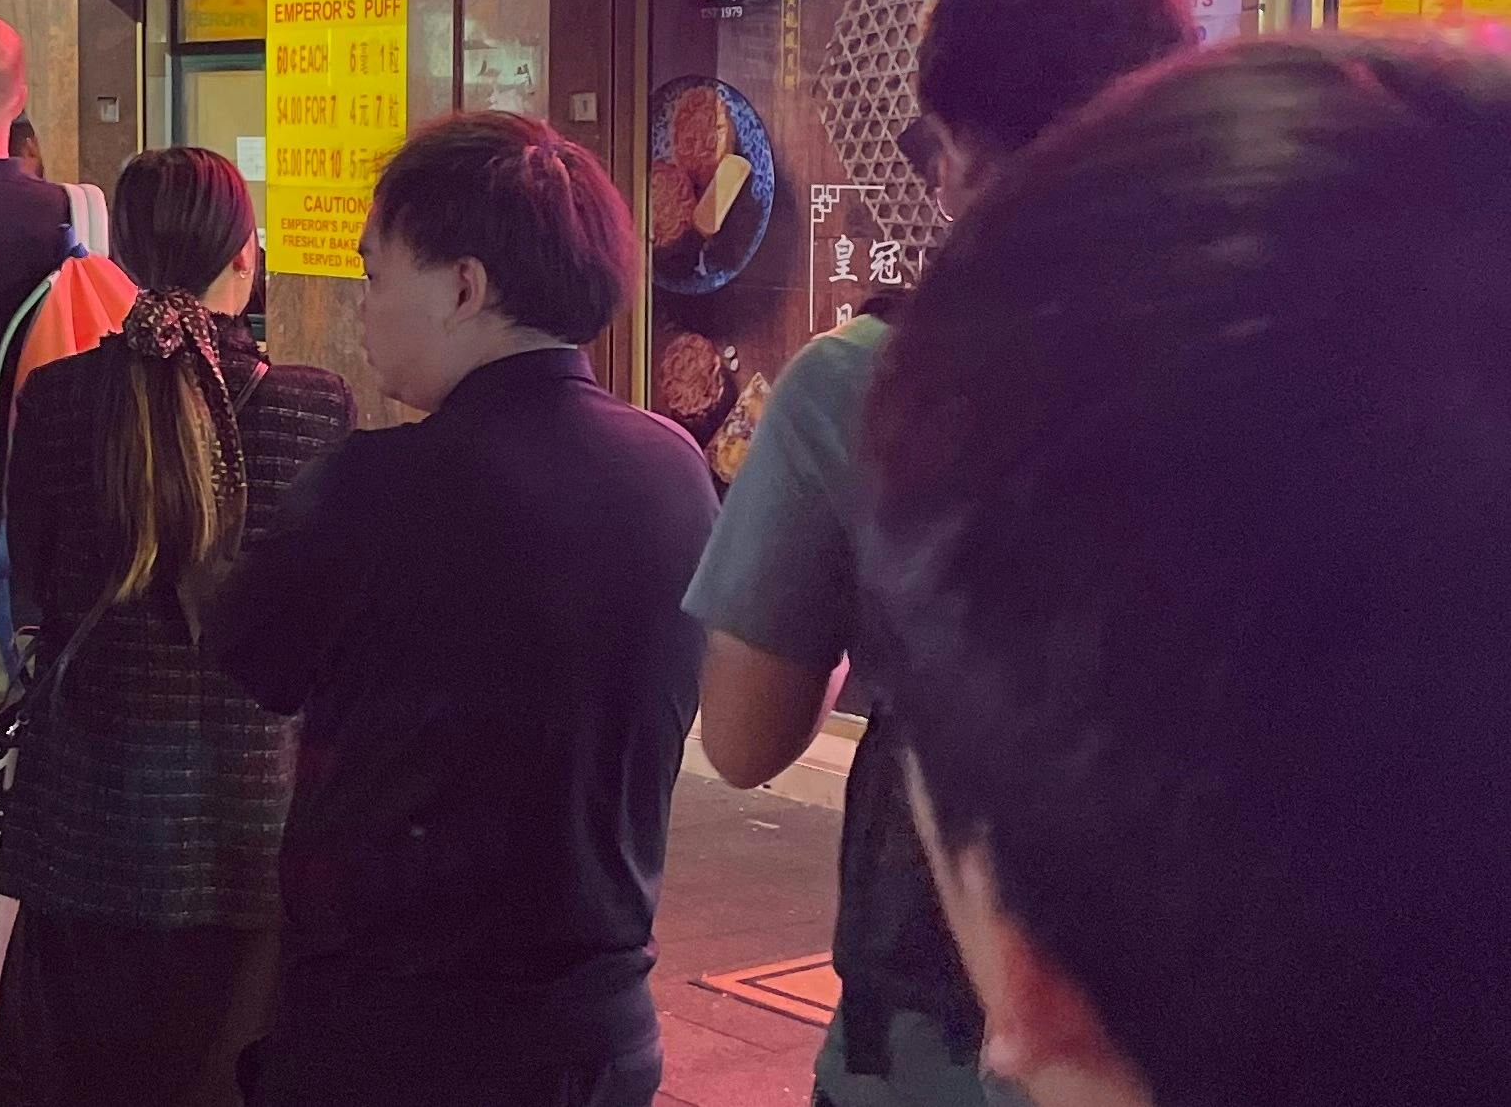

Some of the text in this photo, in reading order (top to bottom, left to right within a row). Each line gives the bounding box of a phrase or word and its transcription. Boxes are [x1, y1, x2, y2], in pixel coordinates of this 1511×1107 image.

[274, 0, 357, 24] EMPEROR'S
[720, 5, 744, 19] 1979
[303, 195, 367, 214] CAUTION
[280, 218, 363, 234] EMPEROR'S PUF
[282, 235, 358, 251] FRESHLY BAKE
[302, 252, 361, 268] SERVED HO
[828, 233, 903, 285] 皇冠
